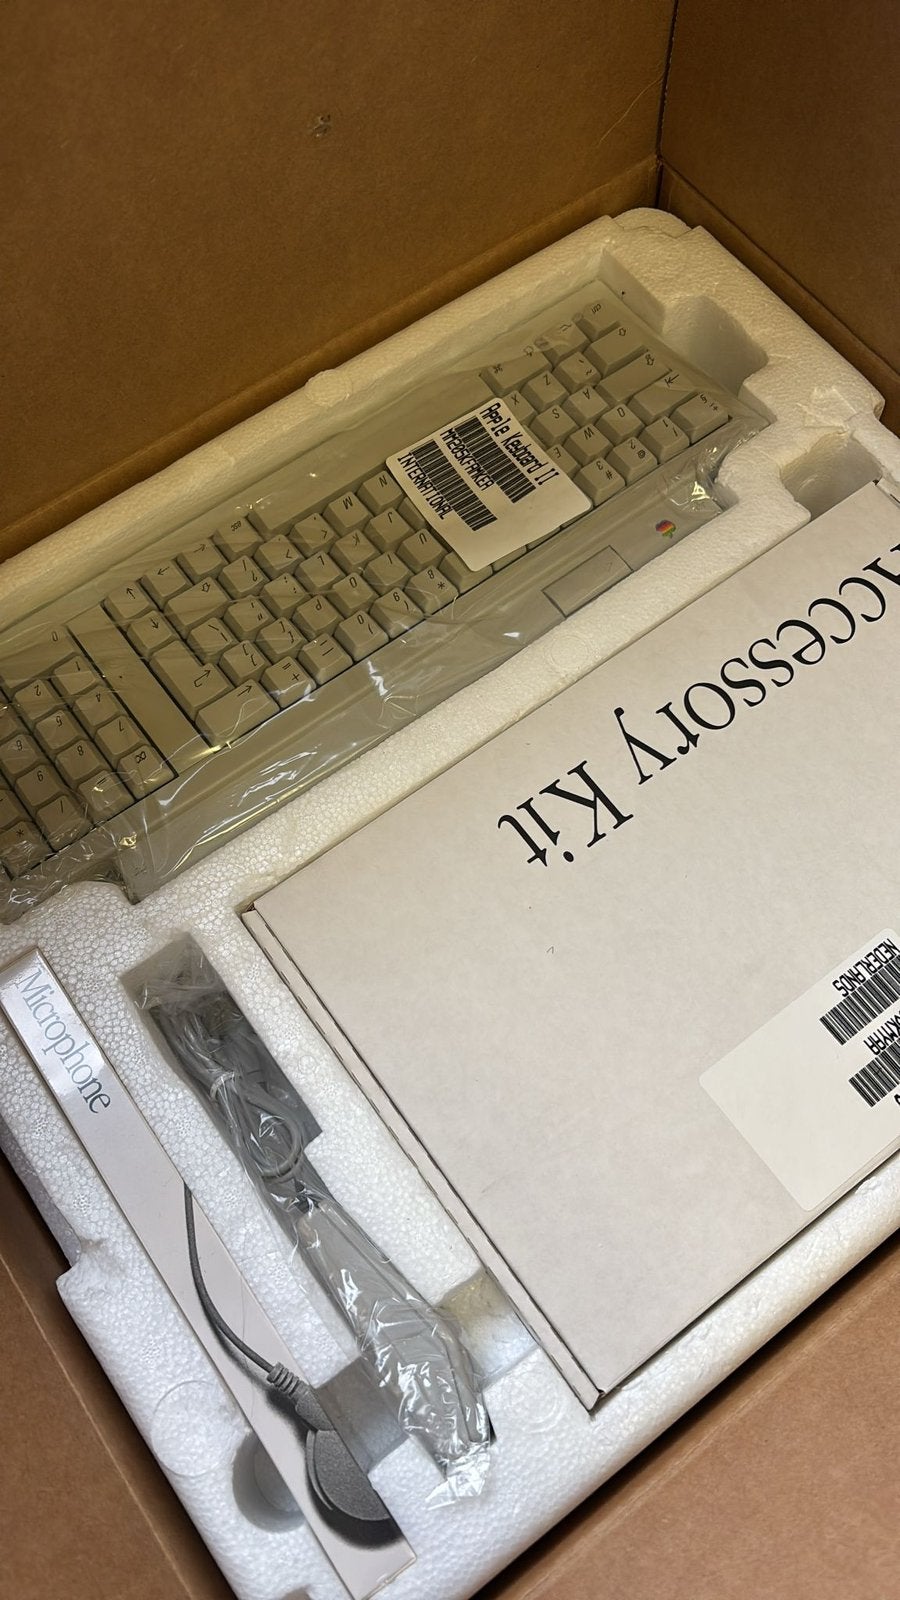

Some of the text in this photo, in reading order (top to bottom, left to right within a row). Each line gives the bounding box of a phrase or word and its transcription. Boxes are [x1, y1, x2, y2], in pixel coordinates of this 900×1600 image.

[543, 374, 551, 386] Z
[510, 394, 520, 405] X
[582, 389, 591, 400] A
[552, 409, 560, 419] S
[583, 428, 594, 440] W
[480, 402, 560, 485] Apple Keyboard II
[629, 440, 636, 450] 2
[553, 447, 561, 458] E
[596, 462, 603, 470] 3
[378, 475, 388, 487] N
[397, 452, 452, 520] INTERNATIONAL
[343, 496, 353, 510] M
[387, 511, 393, 523] J
[231, 520, 241, 531] esc
[352, 533, 360, 546] K
[419, 533, 427, 544] U
[317, 555, 324, 566] L
[427, 569, 434, 579] 8
[393, 592, 400, 602] 9
[315, 598, 323, 611] P
[34, 685, 41, 697] 2
[95, 693, 102, 703] 4
[56, 715, 63, 727] 5
[118, 721, 125, 732] 7
[77, 745, 84, 756] 8
[36, 771, 44, 782] 9
[497, 760, 634, 867] Kit
[832, 938, 900, 998] NEDERLANDS
[15, 969, 111, 1114] Microphone
